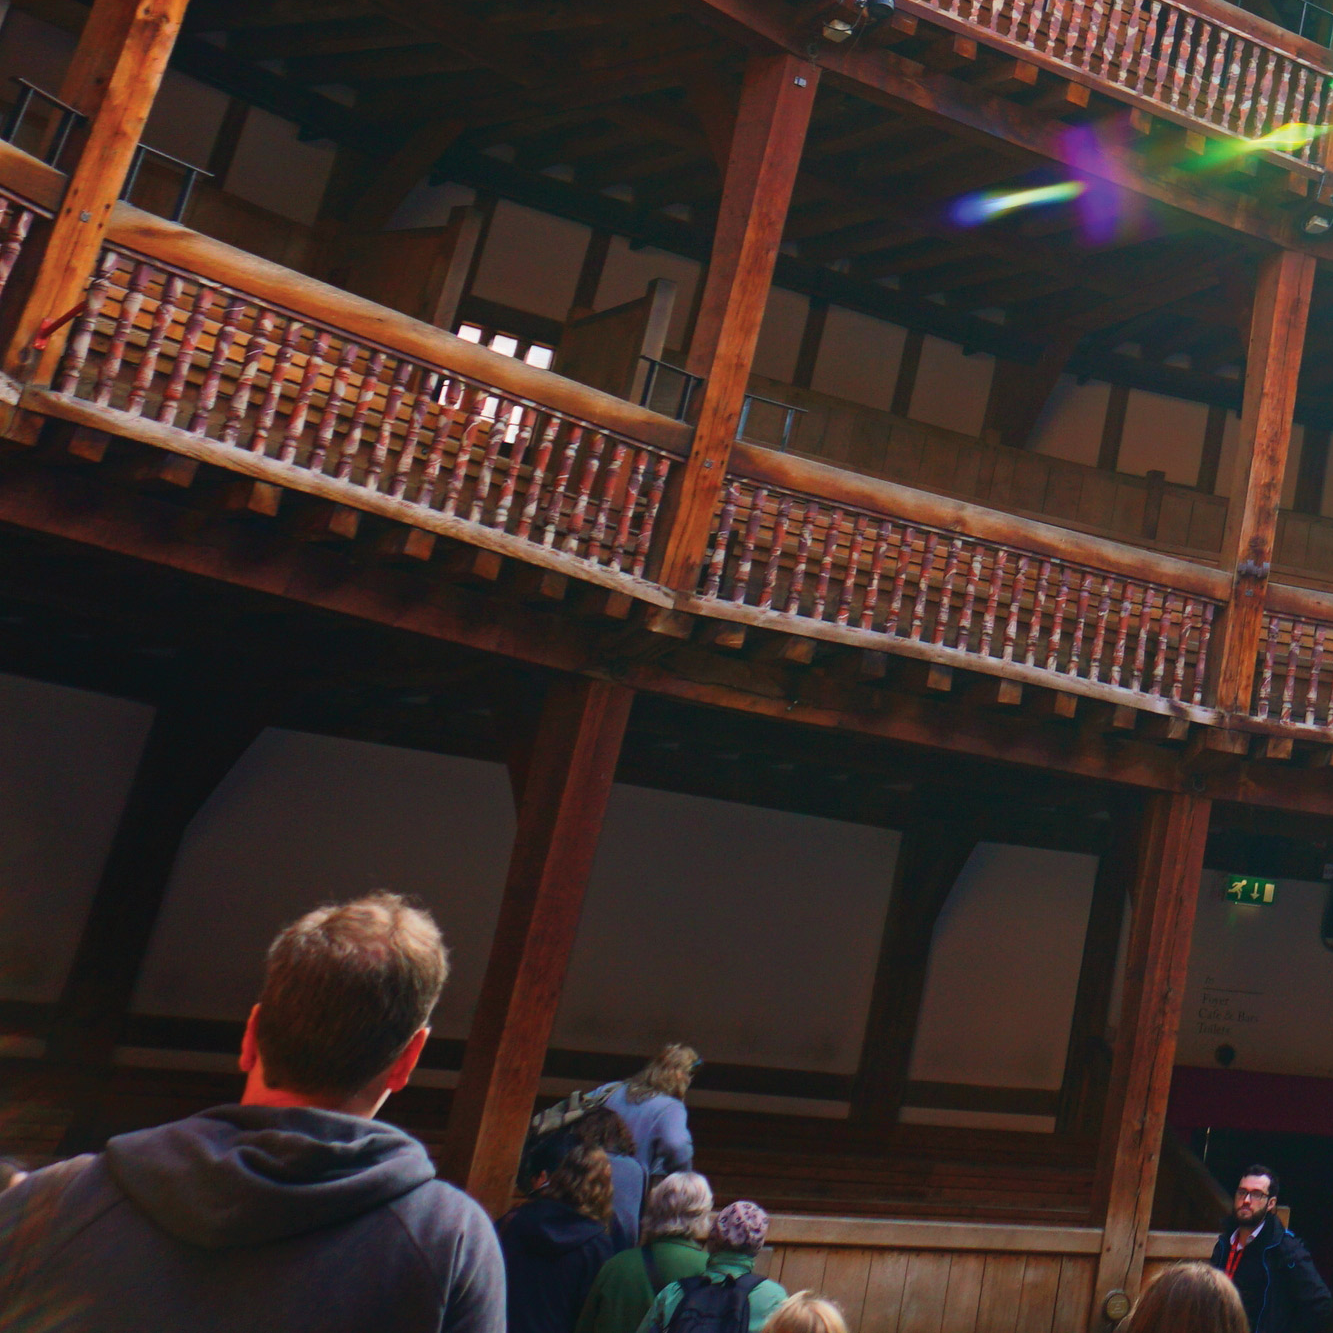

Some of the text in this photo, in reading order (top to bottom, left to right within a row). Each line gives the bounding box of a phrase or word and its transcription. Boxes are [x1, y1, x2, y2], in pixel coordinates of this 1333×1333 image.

[1202, 992, 1230, 1008] Foyer
[1224, 1009, 1235, 1021] &
[1196, 1021, 1232, 1035] Toilets
